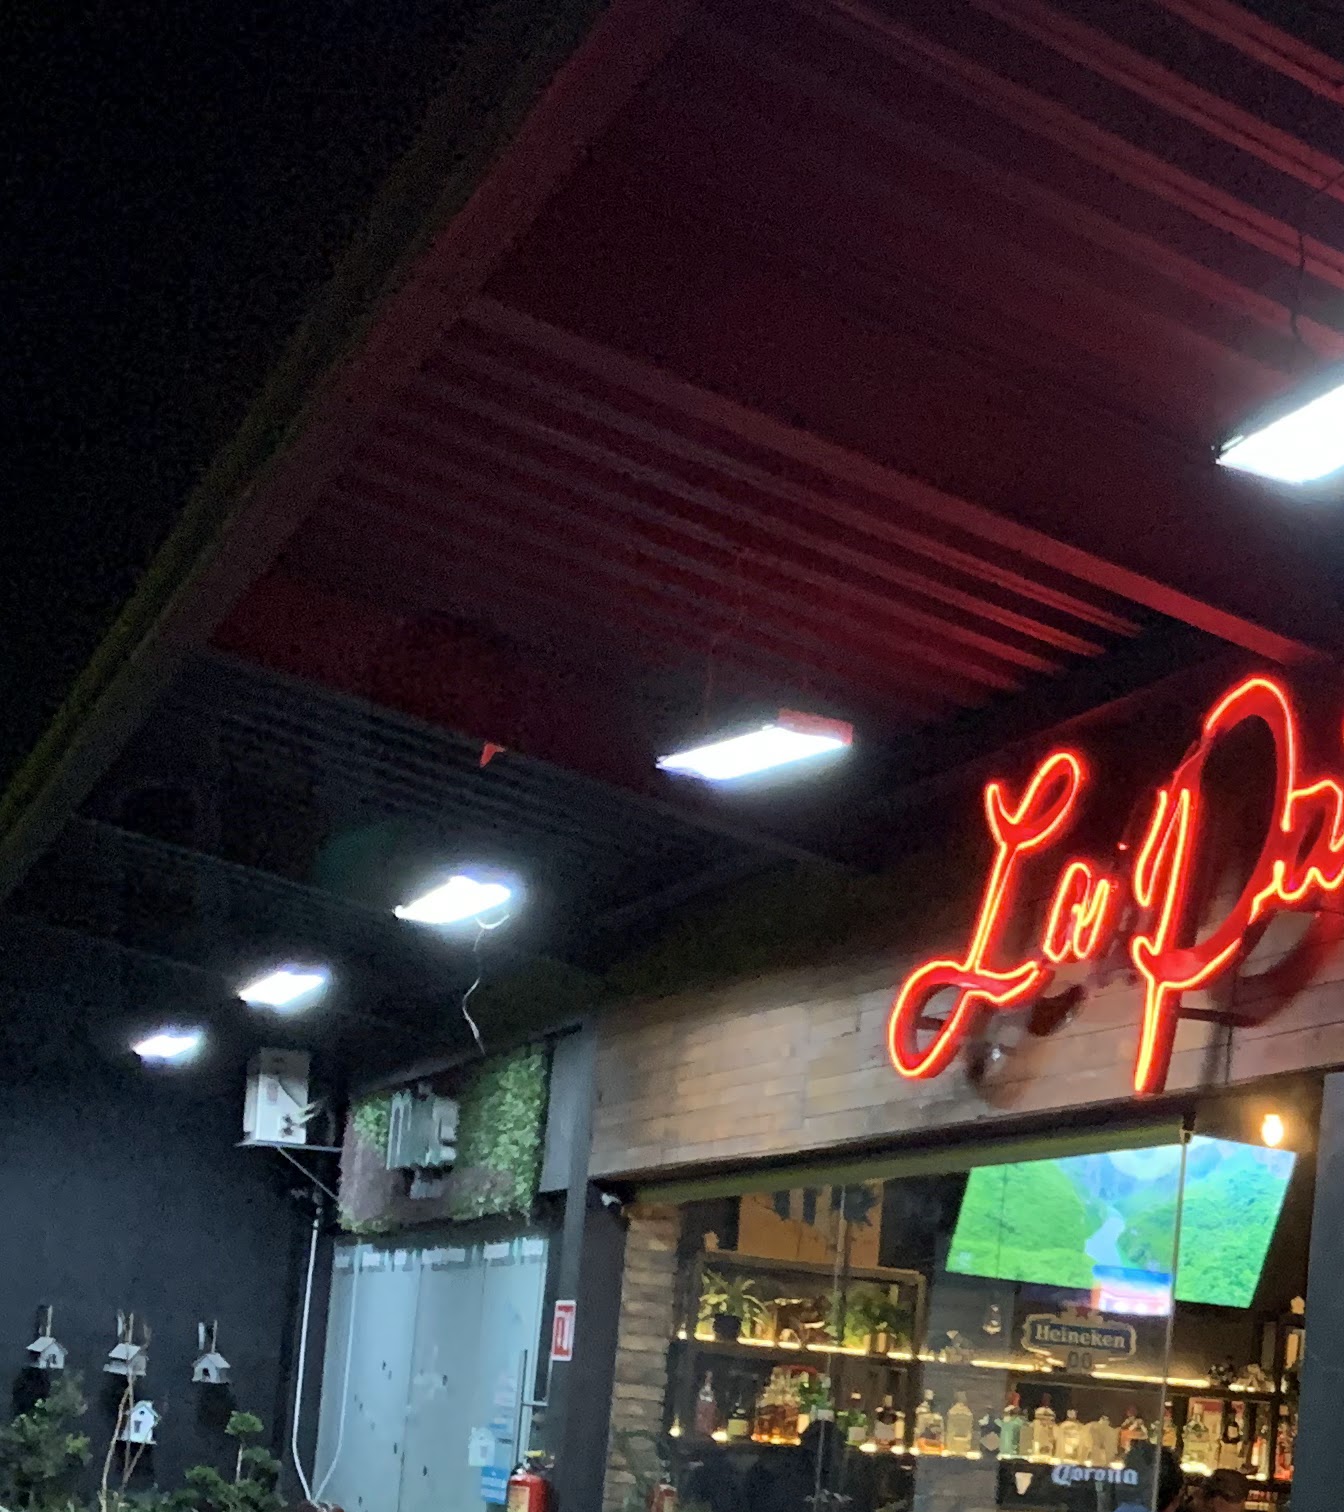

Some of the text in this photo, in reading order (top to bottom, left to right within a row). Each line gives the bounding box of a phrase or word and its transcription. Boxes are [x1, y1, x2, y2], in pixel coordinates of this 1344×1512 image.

[887, 750, 1112, 1080] La
[1034, 1322, 1126, 1349] Heineken
[1051, 1464, 1138, 1486] Corona
